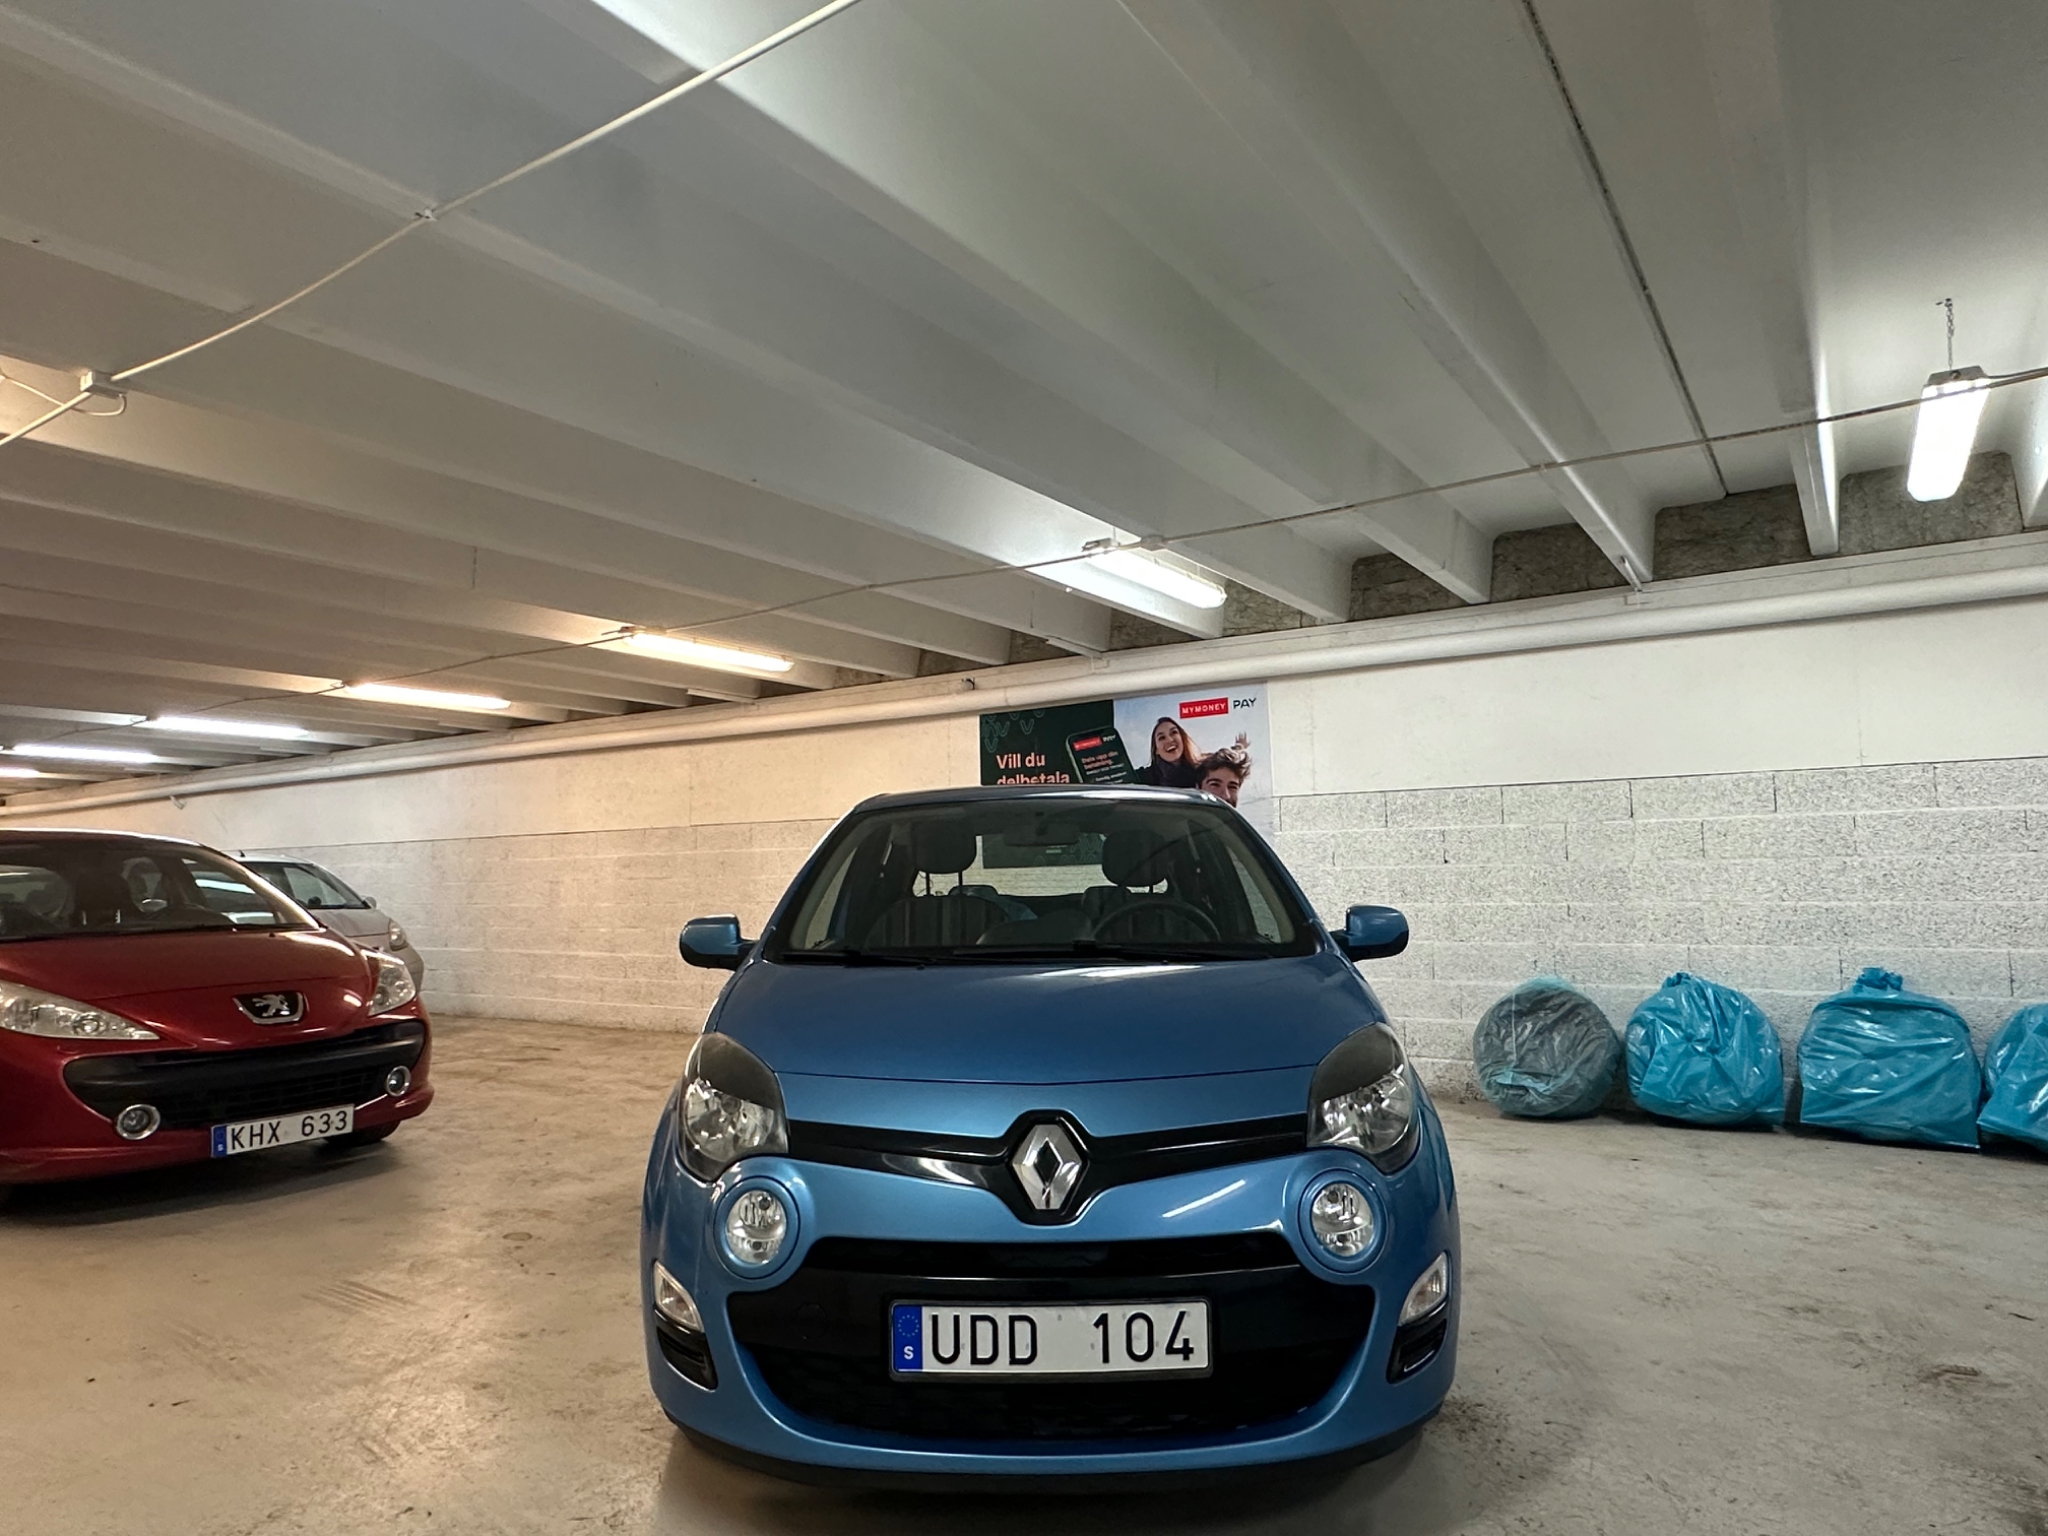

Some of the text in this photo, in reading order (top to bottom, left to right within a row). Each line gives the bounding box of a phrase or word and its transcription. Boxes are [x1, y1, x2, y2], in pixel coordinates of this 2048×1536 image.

[1181, 697, 1257, 714] MYMONEY PAY
[996, 752, 1045, 769] Vill du
[230, 1110, 347, 1150] KHX 633
[931, 1310, 1195, 1366] UDD 104
[903, 1346, 914, 1360] S
